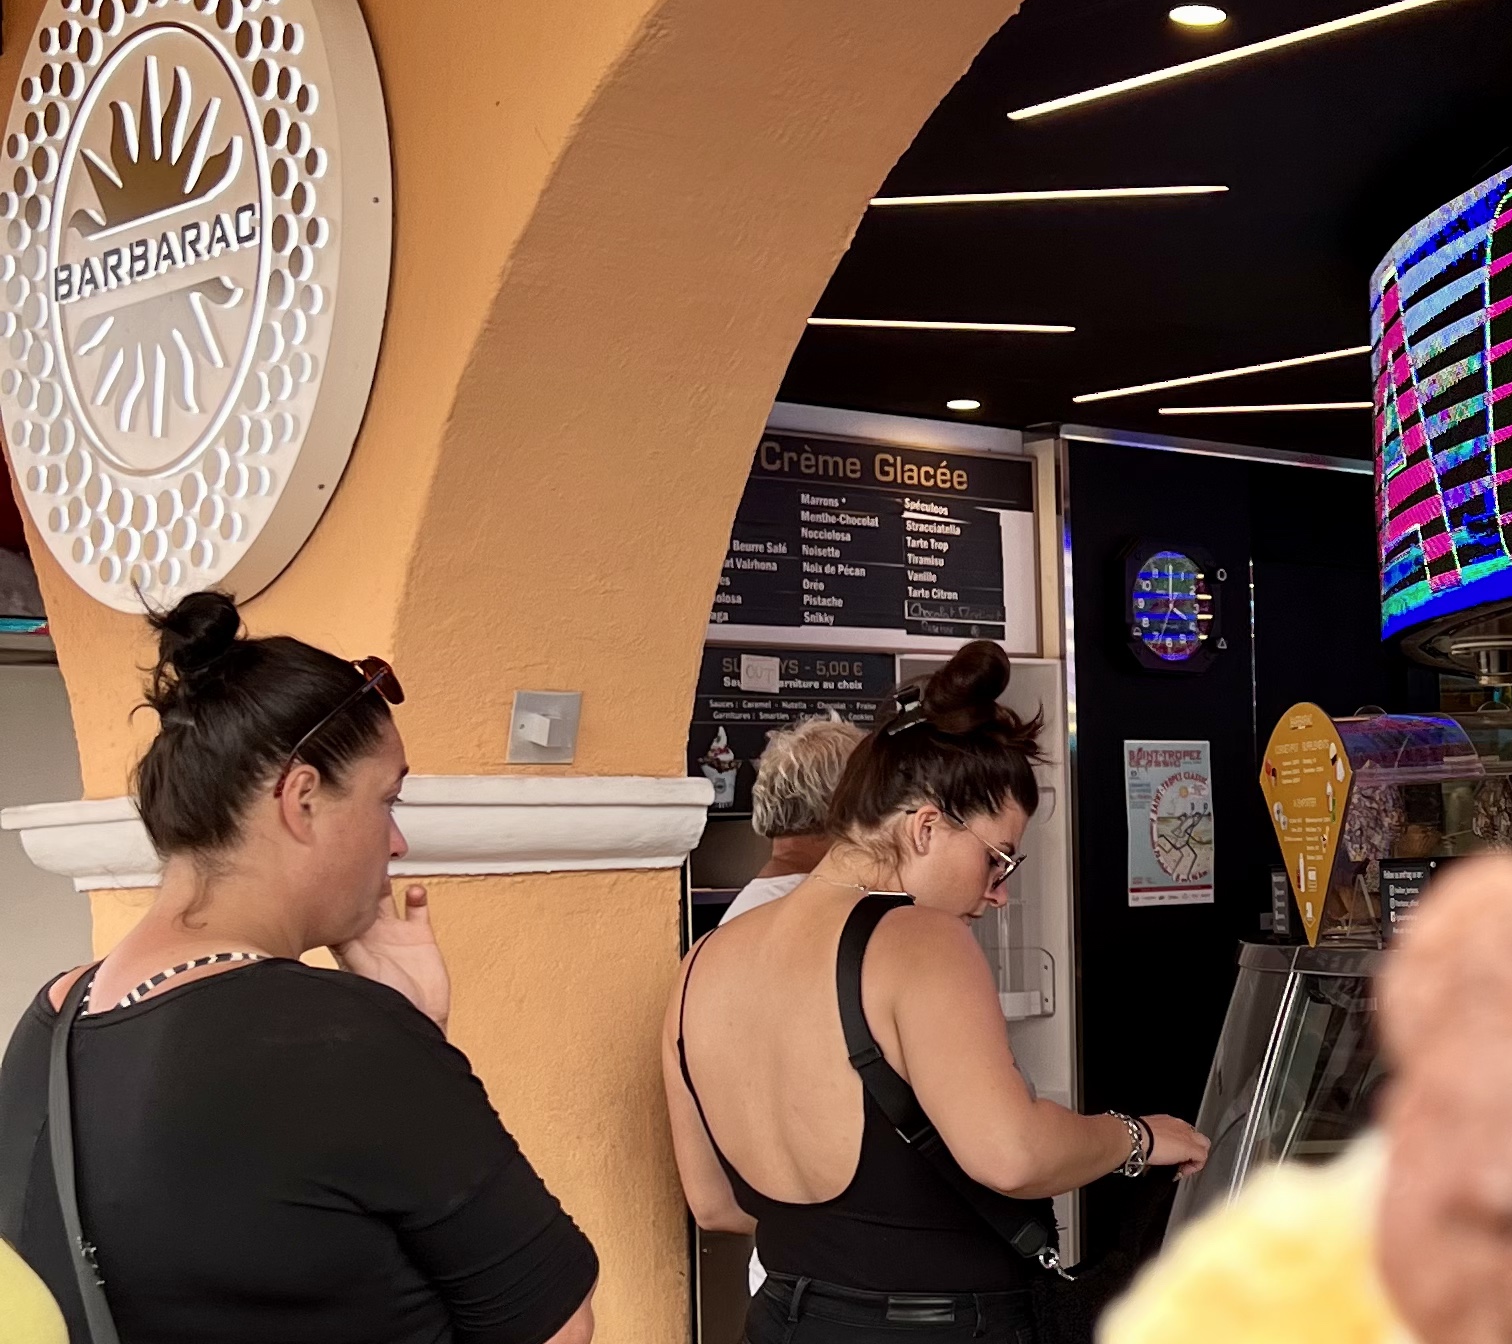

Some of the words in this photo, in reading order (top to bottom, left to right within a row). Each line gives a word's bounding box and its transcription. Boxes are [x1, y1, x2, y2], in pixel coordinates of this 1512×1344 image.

[54, 202, 258, 303] BARBARAC
[760, 441, 862, 479] Crème
[873, 452, 969, 491] Glacée
[800, 493, 840, 508] Marrons
[800, 510, 880, 528] Menthe-Chocolat
[732, 539, 765, 554] Beurre
[766, 542, 788, 555] Salé
[905, 536, 929, 551] Tarte
[801, 544, 841, 559] Noisette
[906, 553, 945, 567] Tiramisu
[802, 562, 823, 574] Noix
[824, 563, 836, 574] de
[837, 563, 866, 577] Pécan
[907, 570, 938, 583] Vanille
[907, 586, 930, 599] Tarte
[802, 594, 844, 608] Pistache
[837, 679, 863, 690] choix
